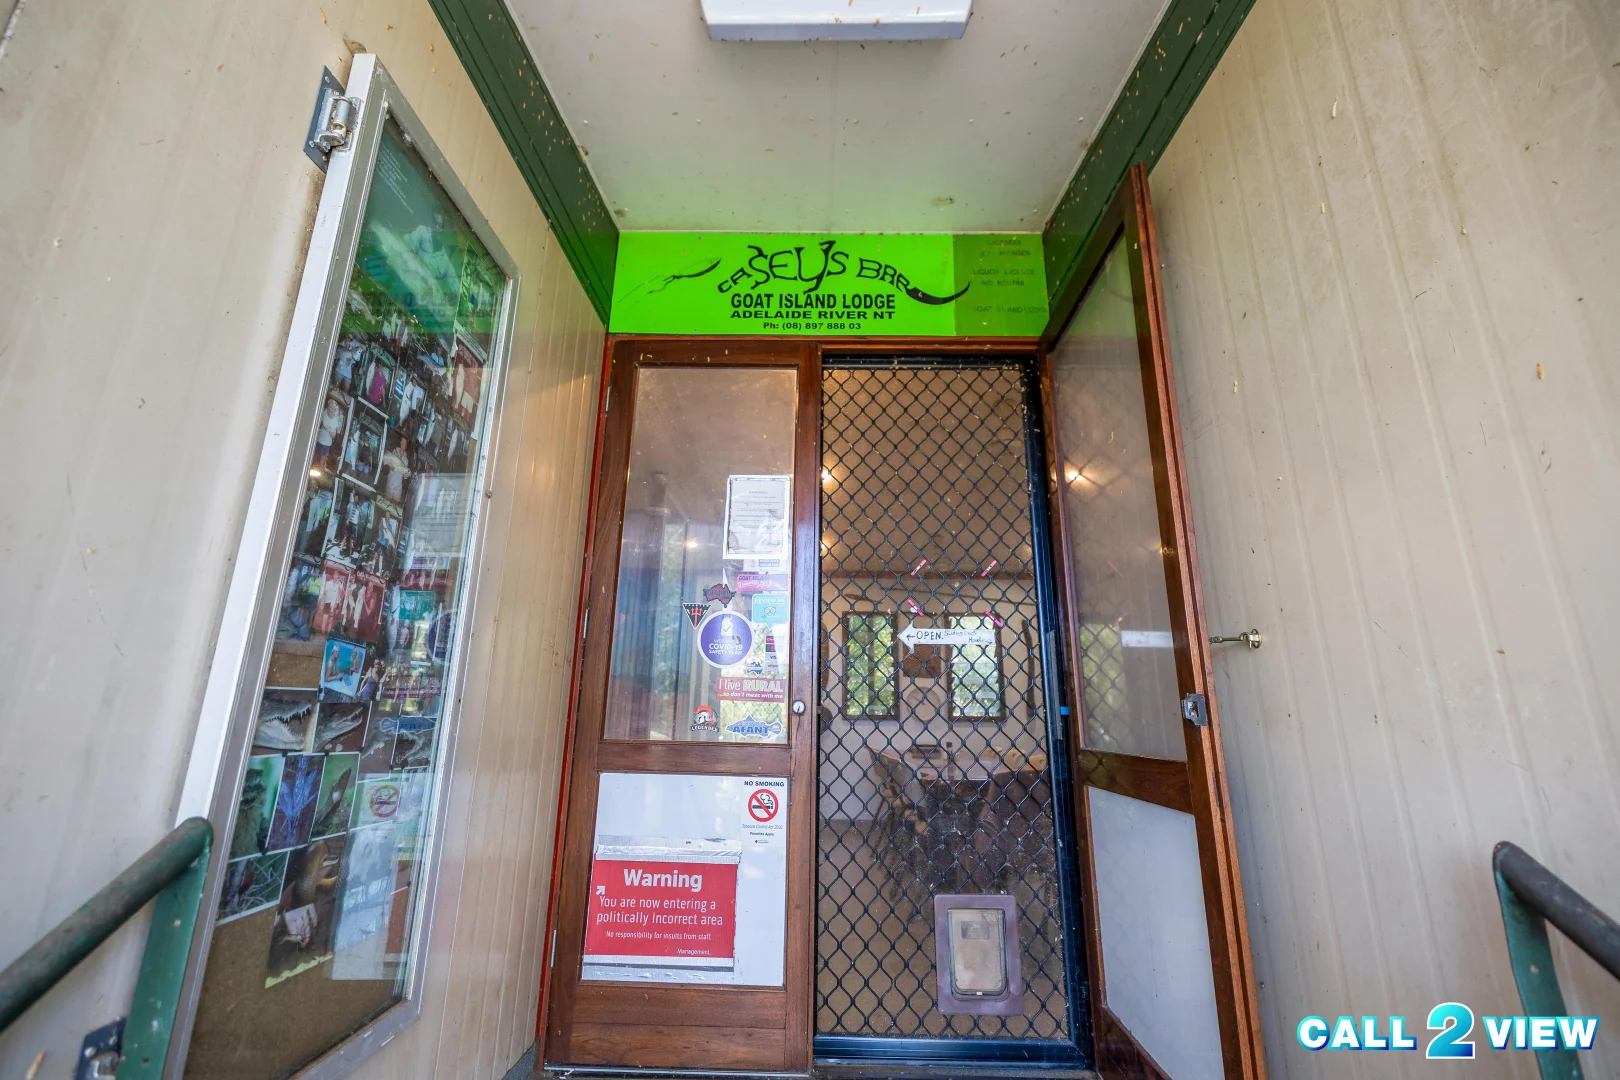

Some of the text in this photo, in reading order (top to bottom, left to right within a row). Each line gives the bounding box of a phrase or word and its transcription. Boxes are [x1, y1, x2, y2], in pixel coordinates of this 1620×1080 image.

[730, 293, 896, 309] GOAT ISLAND LODGE
[730, 310, 896, 320] ADELAIDE RIVER NT
[763, 322, 779, 330] Ph:
[782, 322, 803, 332] (08)
[805, 322, 824, 330] 897
[827, 322, 846, 330] 888
[708, 643, 743, 651] COVID-19
[724, 678, 741, 691] live
[742, 679, 784, 692] RURAL
[755, 780, 785, 788] SMOKING
[623, 868, 703, 892] Warning
[599, 895, 717, 912] You are now entering a
[596, 911, 723, 926] politically incorrect area
[615, 931, 653, 940] responsibility
[653, 931, 662, 939] for
[663, 932, 682, 940] insults
[683, 932, 697, 940] from
